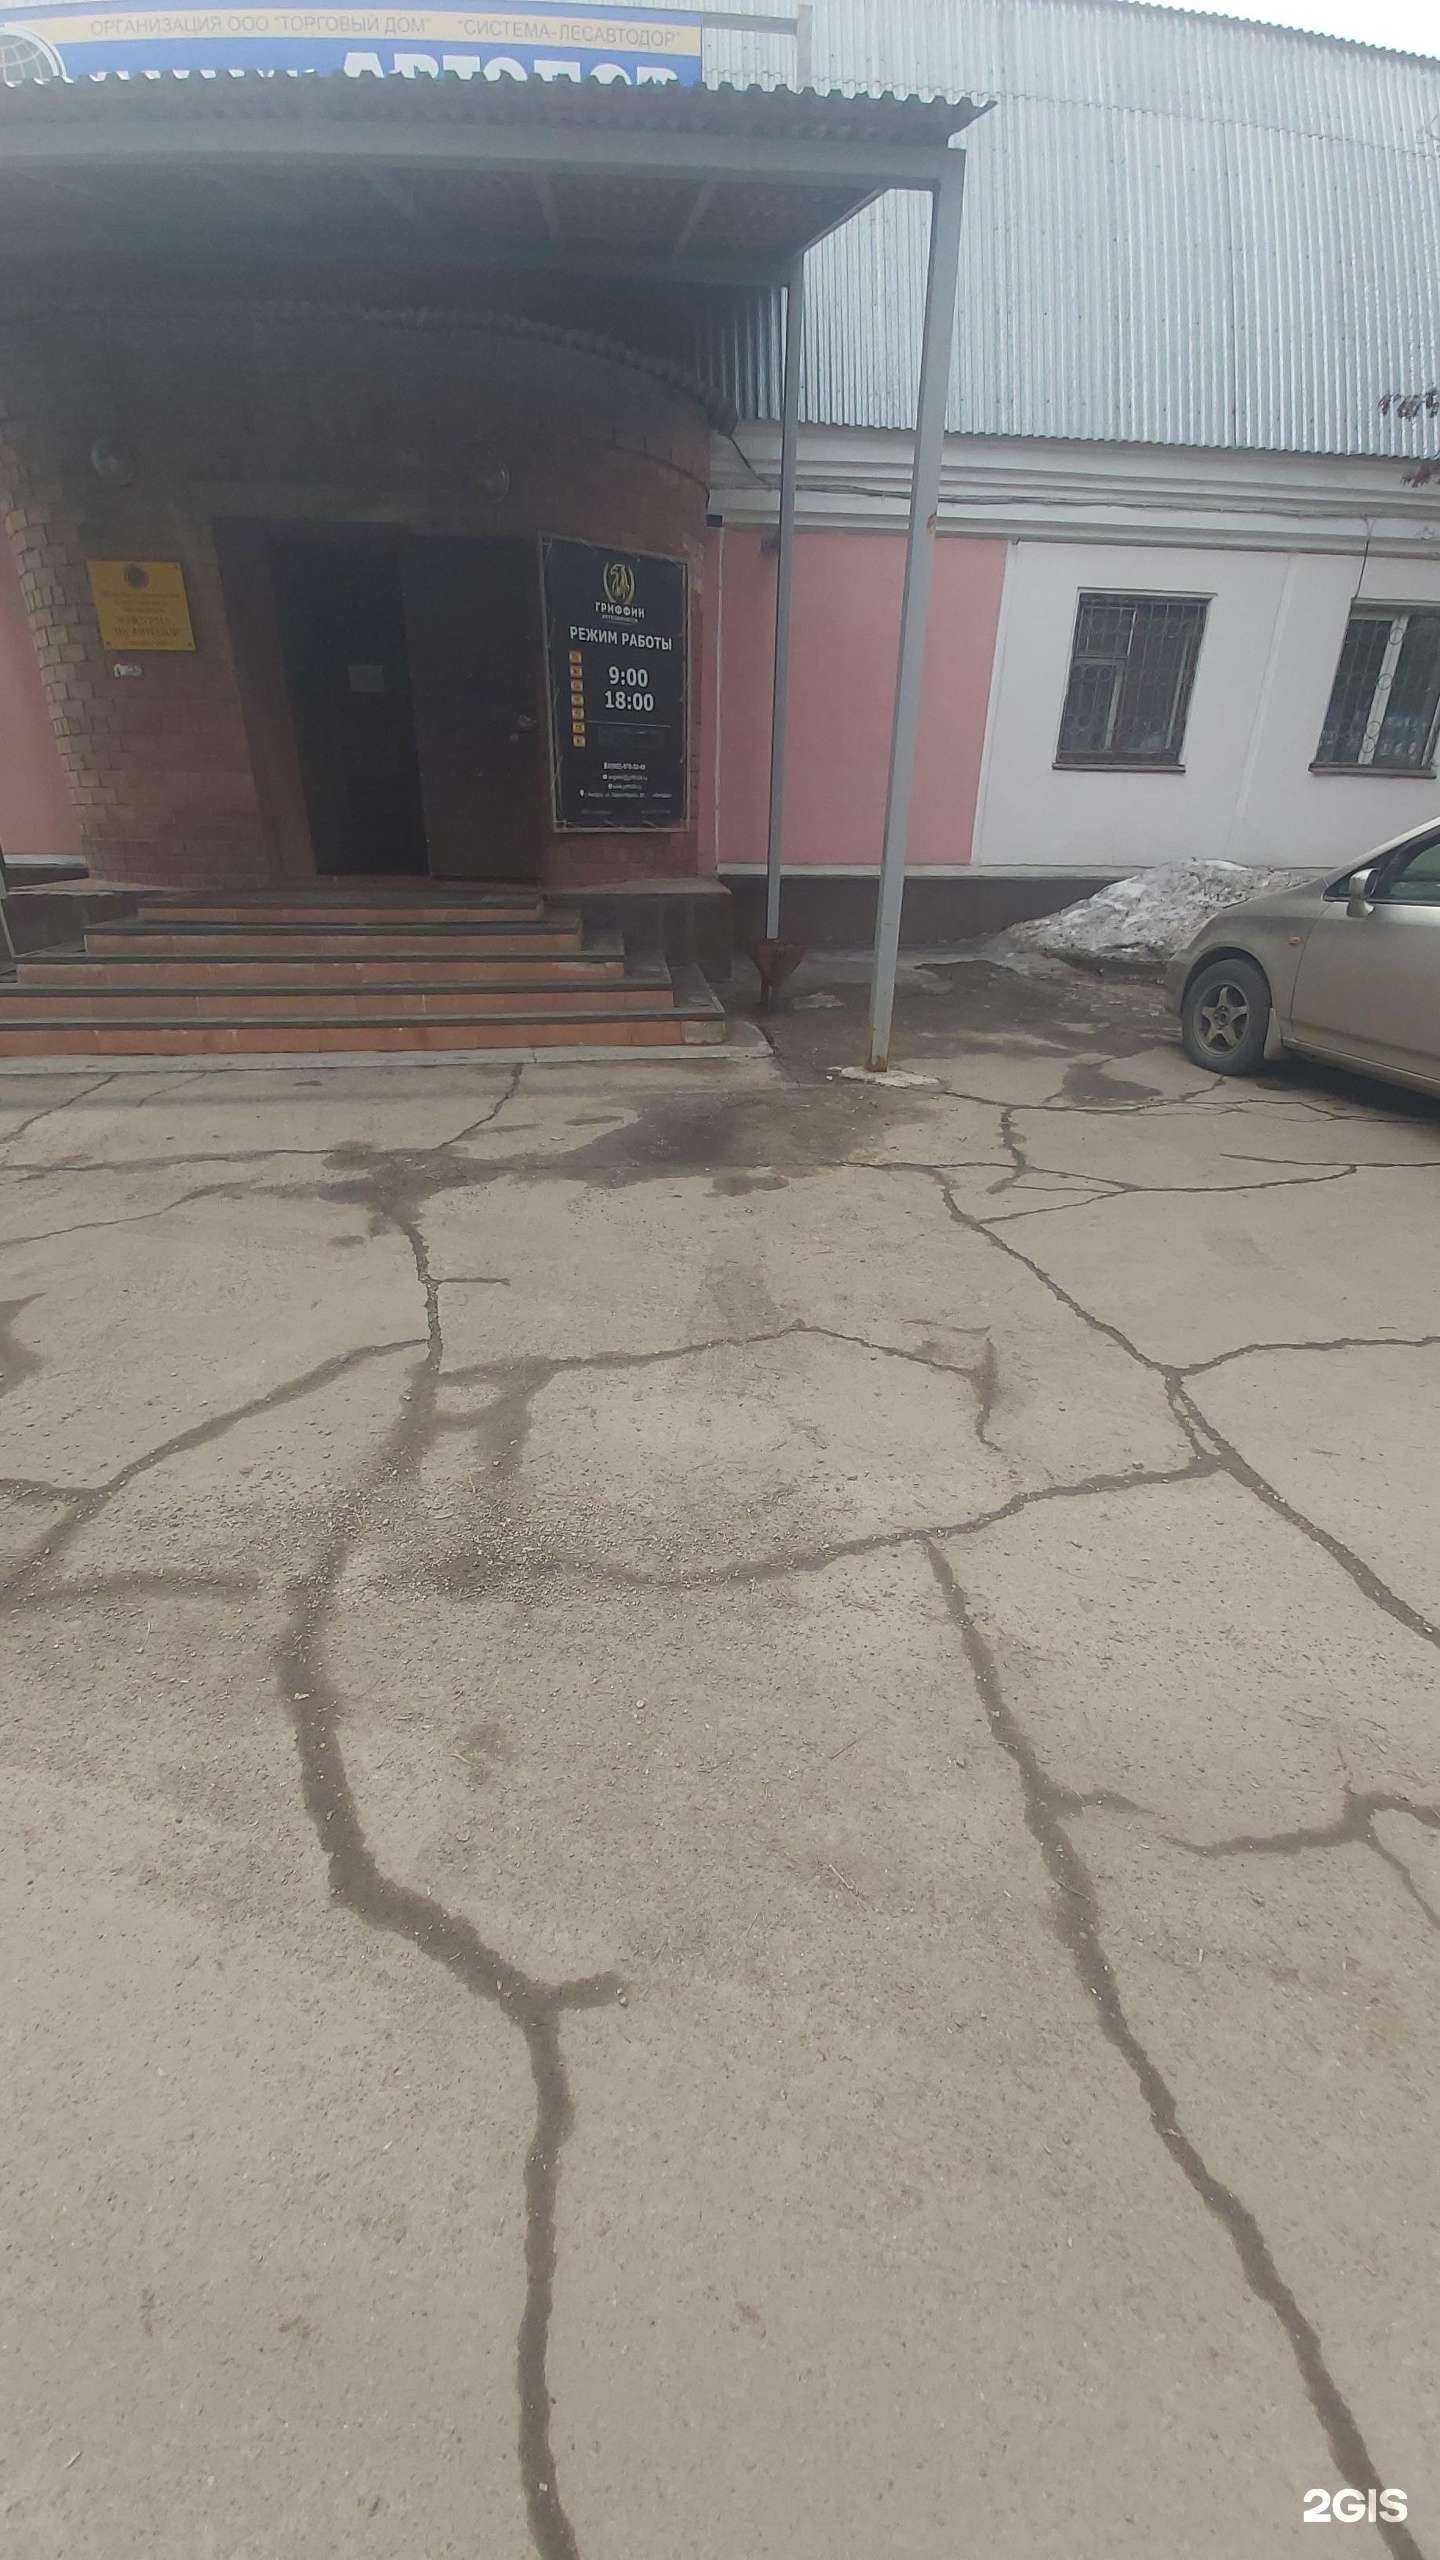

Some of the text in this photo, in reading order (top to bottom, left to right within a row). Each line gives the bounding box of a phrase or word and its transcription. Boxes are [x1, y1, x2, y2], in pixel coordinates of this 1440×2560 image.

[90, 16, 222, 36] ОРГАНИЗАЦИЯ
[227, 15, 269, 33] ООО
[595, 601, 645, 619] ГРИФФИН
[569, 625, 673, 651] РЕЖИМ РАБОТЫ
[608, 665, 649, 688] 9:00
[604, 690, 654, 711] 18:00
